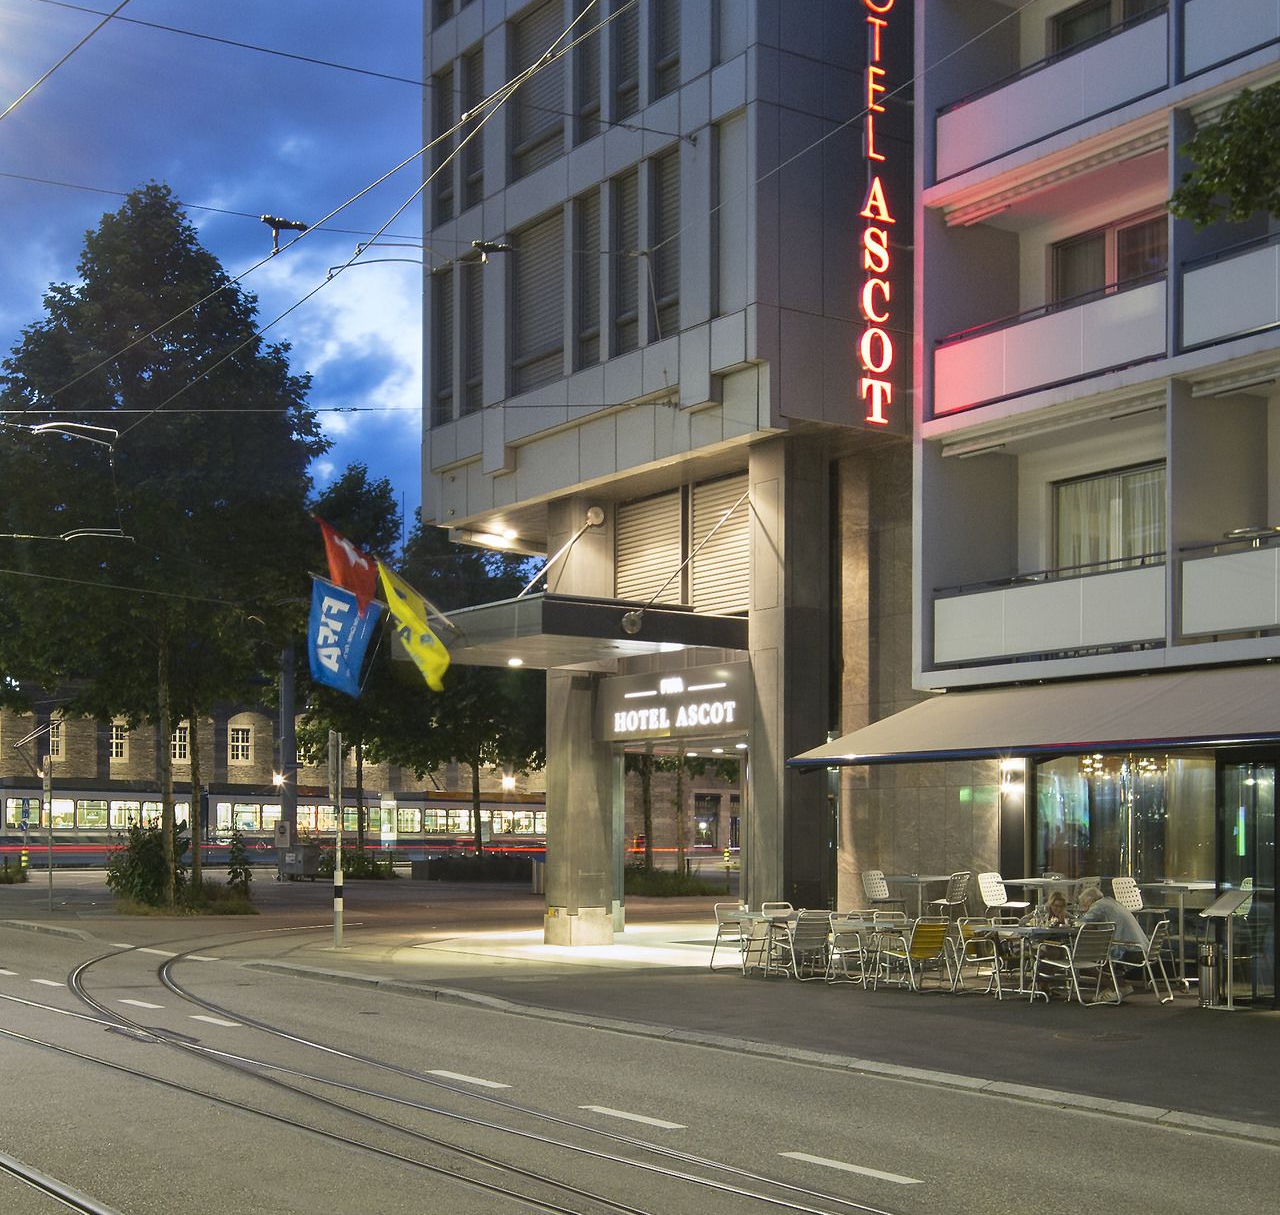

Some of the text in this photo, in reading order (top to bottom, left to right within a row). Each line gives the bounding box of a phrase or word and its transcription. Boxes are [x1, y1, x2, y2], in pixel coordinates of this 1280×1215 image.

[859, 175, 896, 424] ASCOT
[614, 700, 736, 732] HOTEL ASCOT
